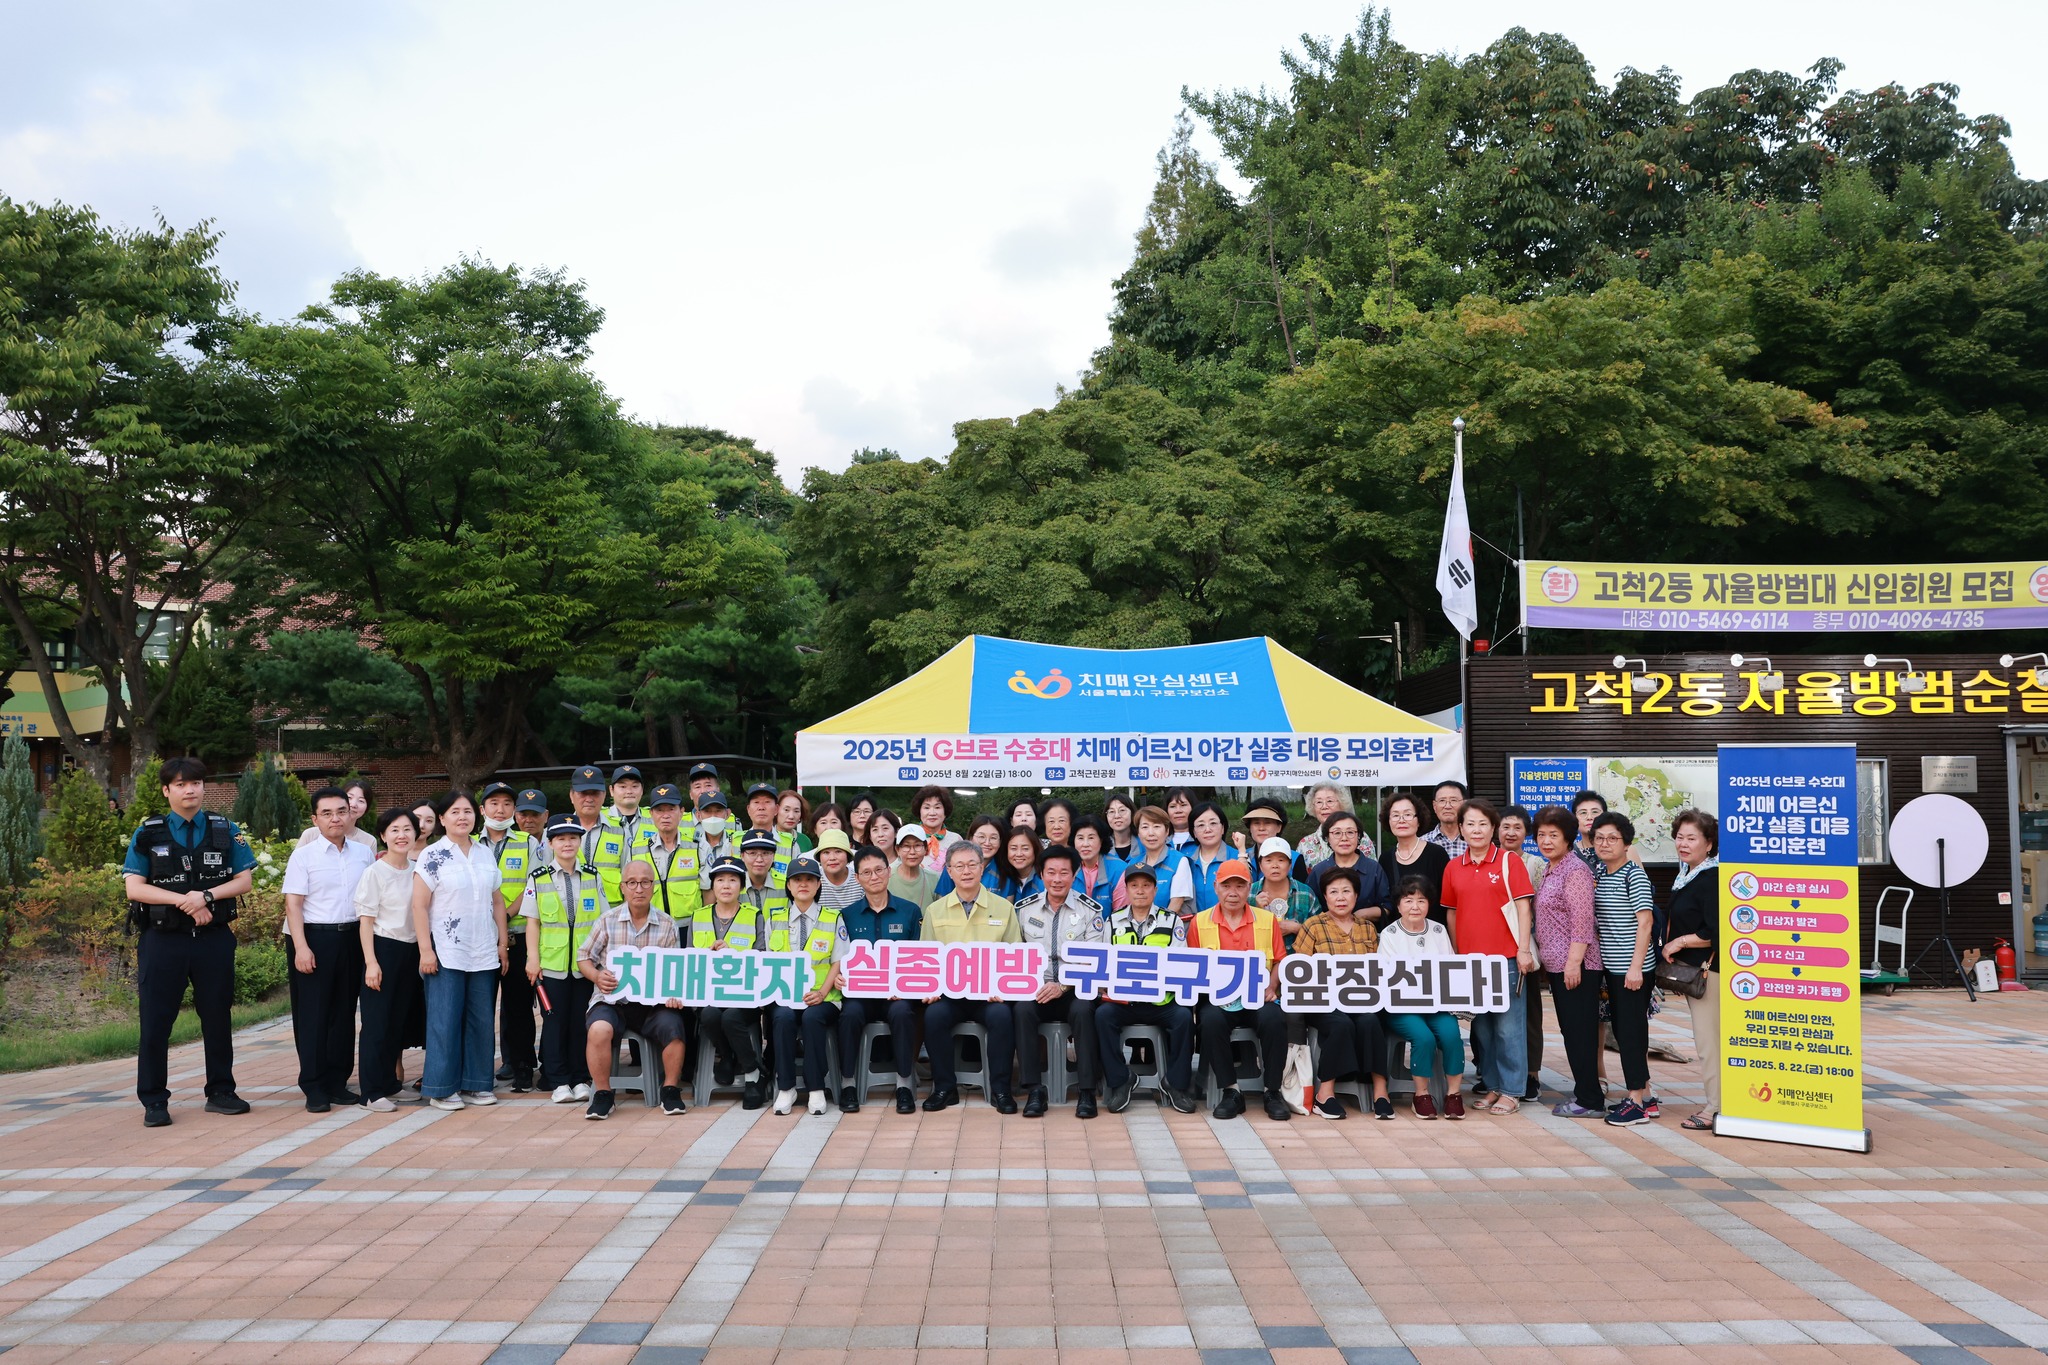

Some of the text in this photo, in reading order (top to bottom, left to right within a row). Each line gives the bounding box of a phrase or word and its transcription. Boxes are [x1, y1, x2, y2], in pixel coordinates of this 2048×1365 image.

[1548, 572, 1571, 597] 환
[1594, 570, 1693, 603] 고척2동
[1702, 573, 1836, 604] 자율방범대
[1847, 572, 1952, 604] 신입회원
[1962, 570, 2014, 602] 모집
[1622, 610, 1984, 630] 대장 010-5469-6114 총무 010-4096-4735
[1078, 671, 1239, 688] 치매안심센터
[1079, 688, 1229, 697] 서울특별시 구로구보건소
[1531, 671, 1727, 716] 고척2동
[843, 737, 1434, 762] 2025년 G브로 수호대 치매 어르신 야간 실종 대응 모의훈련
[900, 769, 918, 778] 일시
[922, 769, 952, 779] 2025년
[955, 769, 969, 779] 8월
[972, 769, 1006, 779] 22일(금)
[1047, 769, 1116, 779] 장소 고척근린공원
[1131, 769, 1147, 778] 주최
[1172, 769, 1215, 778] 구로구보건소
[1230, 769, 1247, 778] 주관
[1267, 769, 1322, 778] 구로구치매안심센터
[1344, 769, 1379, 778] 구로경찰서
[1519, 771, 1582, 781] 자율방범대원 모집
[1729, 776, 1845, 788] 2025년 G브로 수호대
[1737, 795, 1837, 814] 치매 어르신
[1726, 816, 1850, 836] 야간 실종 대응
[1749, 837, 1826, 856] 모의훈련
[199, 869, 227, 880] PCE
[1763, 882, 1830, 894] 야간 순찰 실시
[1763, 915, 1817, 928] 대상자 발견
[1763, 949, 1805, 960] 112 신고
[612, 951, 809, 1003] 치매환자
[847, 946, 1042, 996] 실종예방
[1064, 947, 1263, 1004] 구로구가
[1284, 959, 1502, 1007] 앞장선다!
[1764, 982, 1842, 997] 안전한 귀가 동행
[1744, 1009, 1835, 1027] 치매 어르신의 안전,
[1746, 1023, 1834, 1041] 우리 모두의 관심과
[1729, 1035, 1852, 1056] 실천으로 지킬 수 있습니다.
[1730, 1058, 1854, 1078] 일시 2025. 8. 22.(금) 18:00
[1777, 1087, 1833, 1104] 치매안심센터
